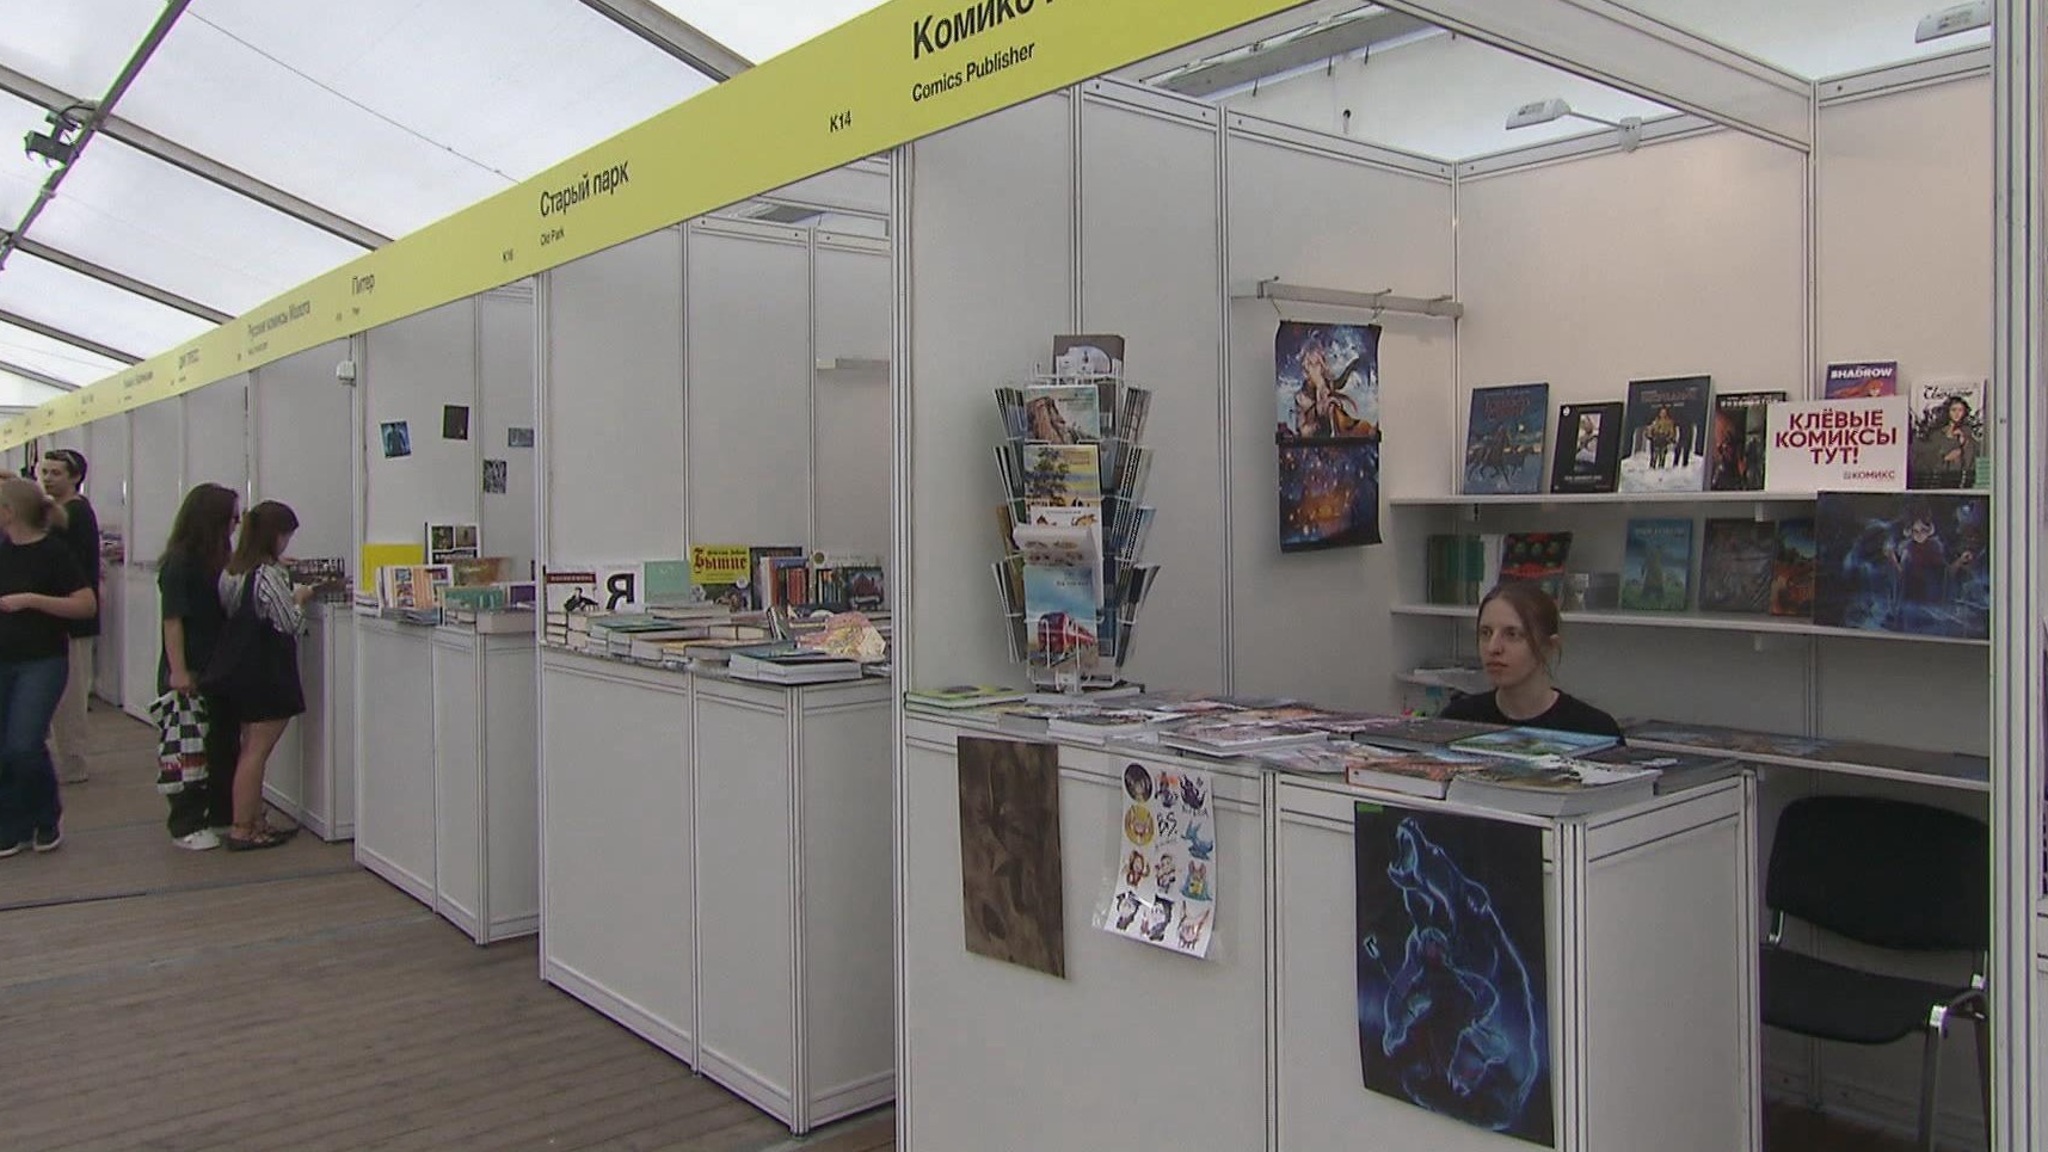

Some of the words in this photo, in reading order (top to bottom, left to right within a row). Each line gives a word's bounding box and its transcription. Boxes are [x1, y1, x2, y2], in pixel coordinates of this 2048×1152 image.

[912, 71, 962, 102] Comics
[966, 42, 1035, 82] Publisher
[540, 171, 590, 218] Старый
[592, 161, 629, 196] парк
[1789, 408, 1883, 430] КЛЁВЫЕ
[1775, 427, 1896, 448] КОМИКСЫ
[1810, 447, 1858, 465] ТУТ!
